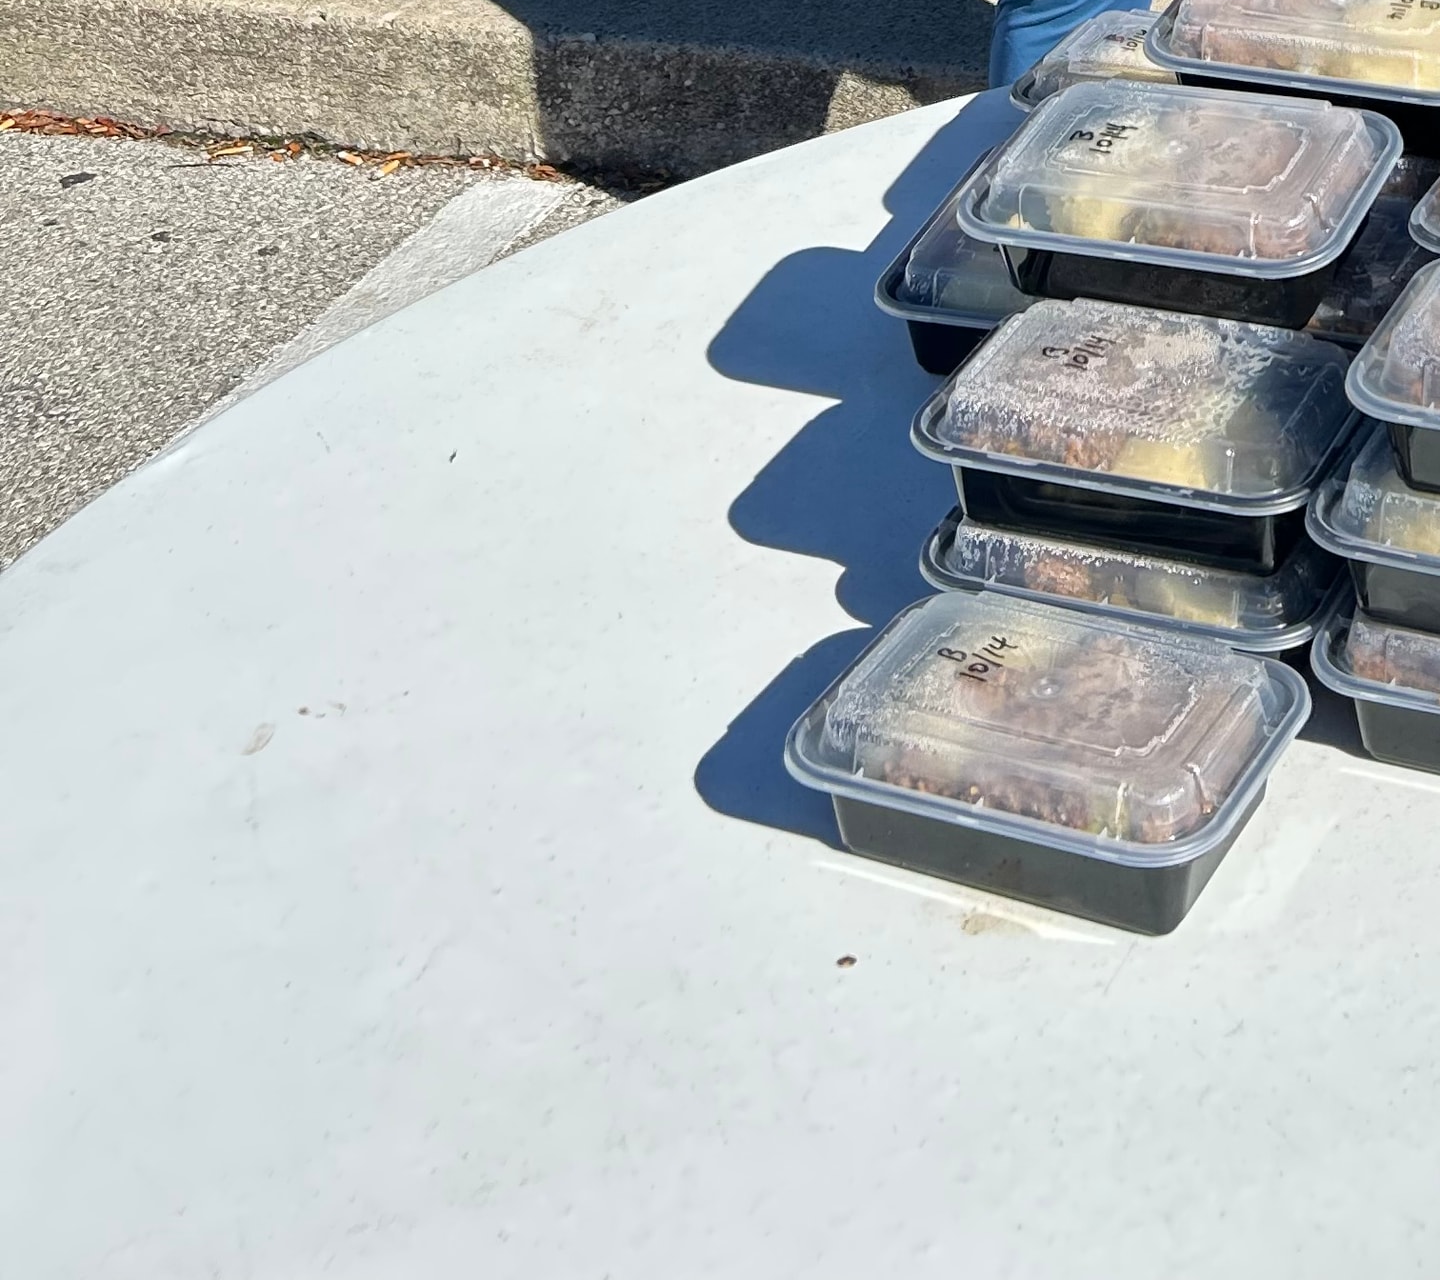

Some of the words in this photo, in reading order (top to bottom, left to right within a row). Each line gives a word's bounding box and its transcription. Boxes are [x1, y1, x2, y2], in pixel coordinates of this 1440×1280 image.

[1088, 122, 1139, 154] 10/14
[1063, 334, 1117, 371] 10/14
[937, 647, 968, 662] B
[958, 635, 1019, 682] 10/14
